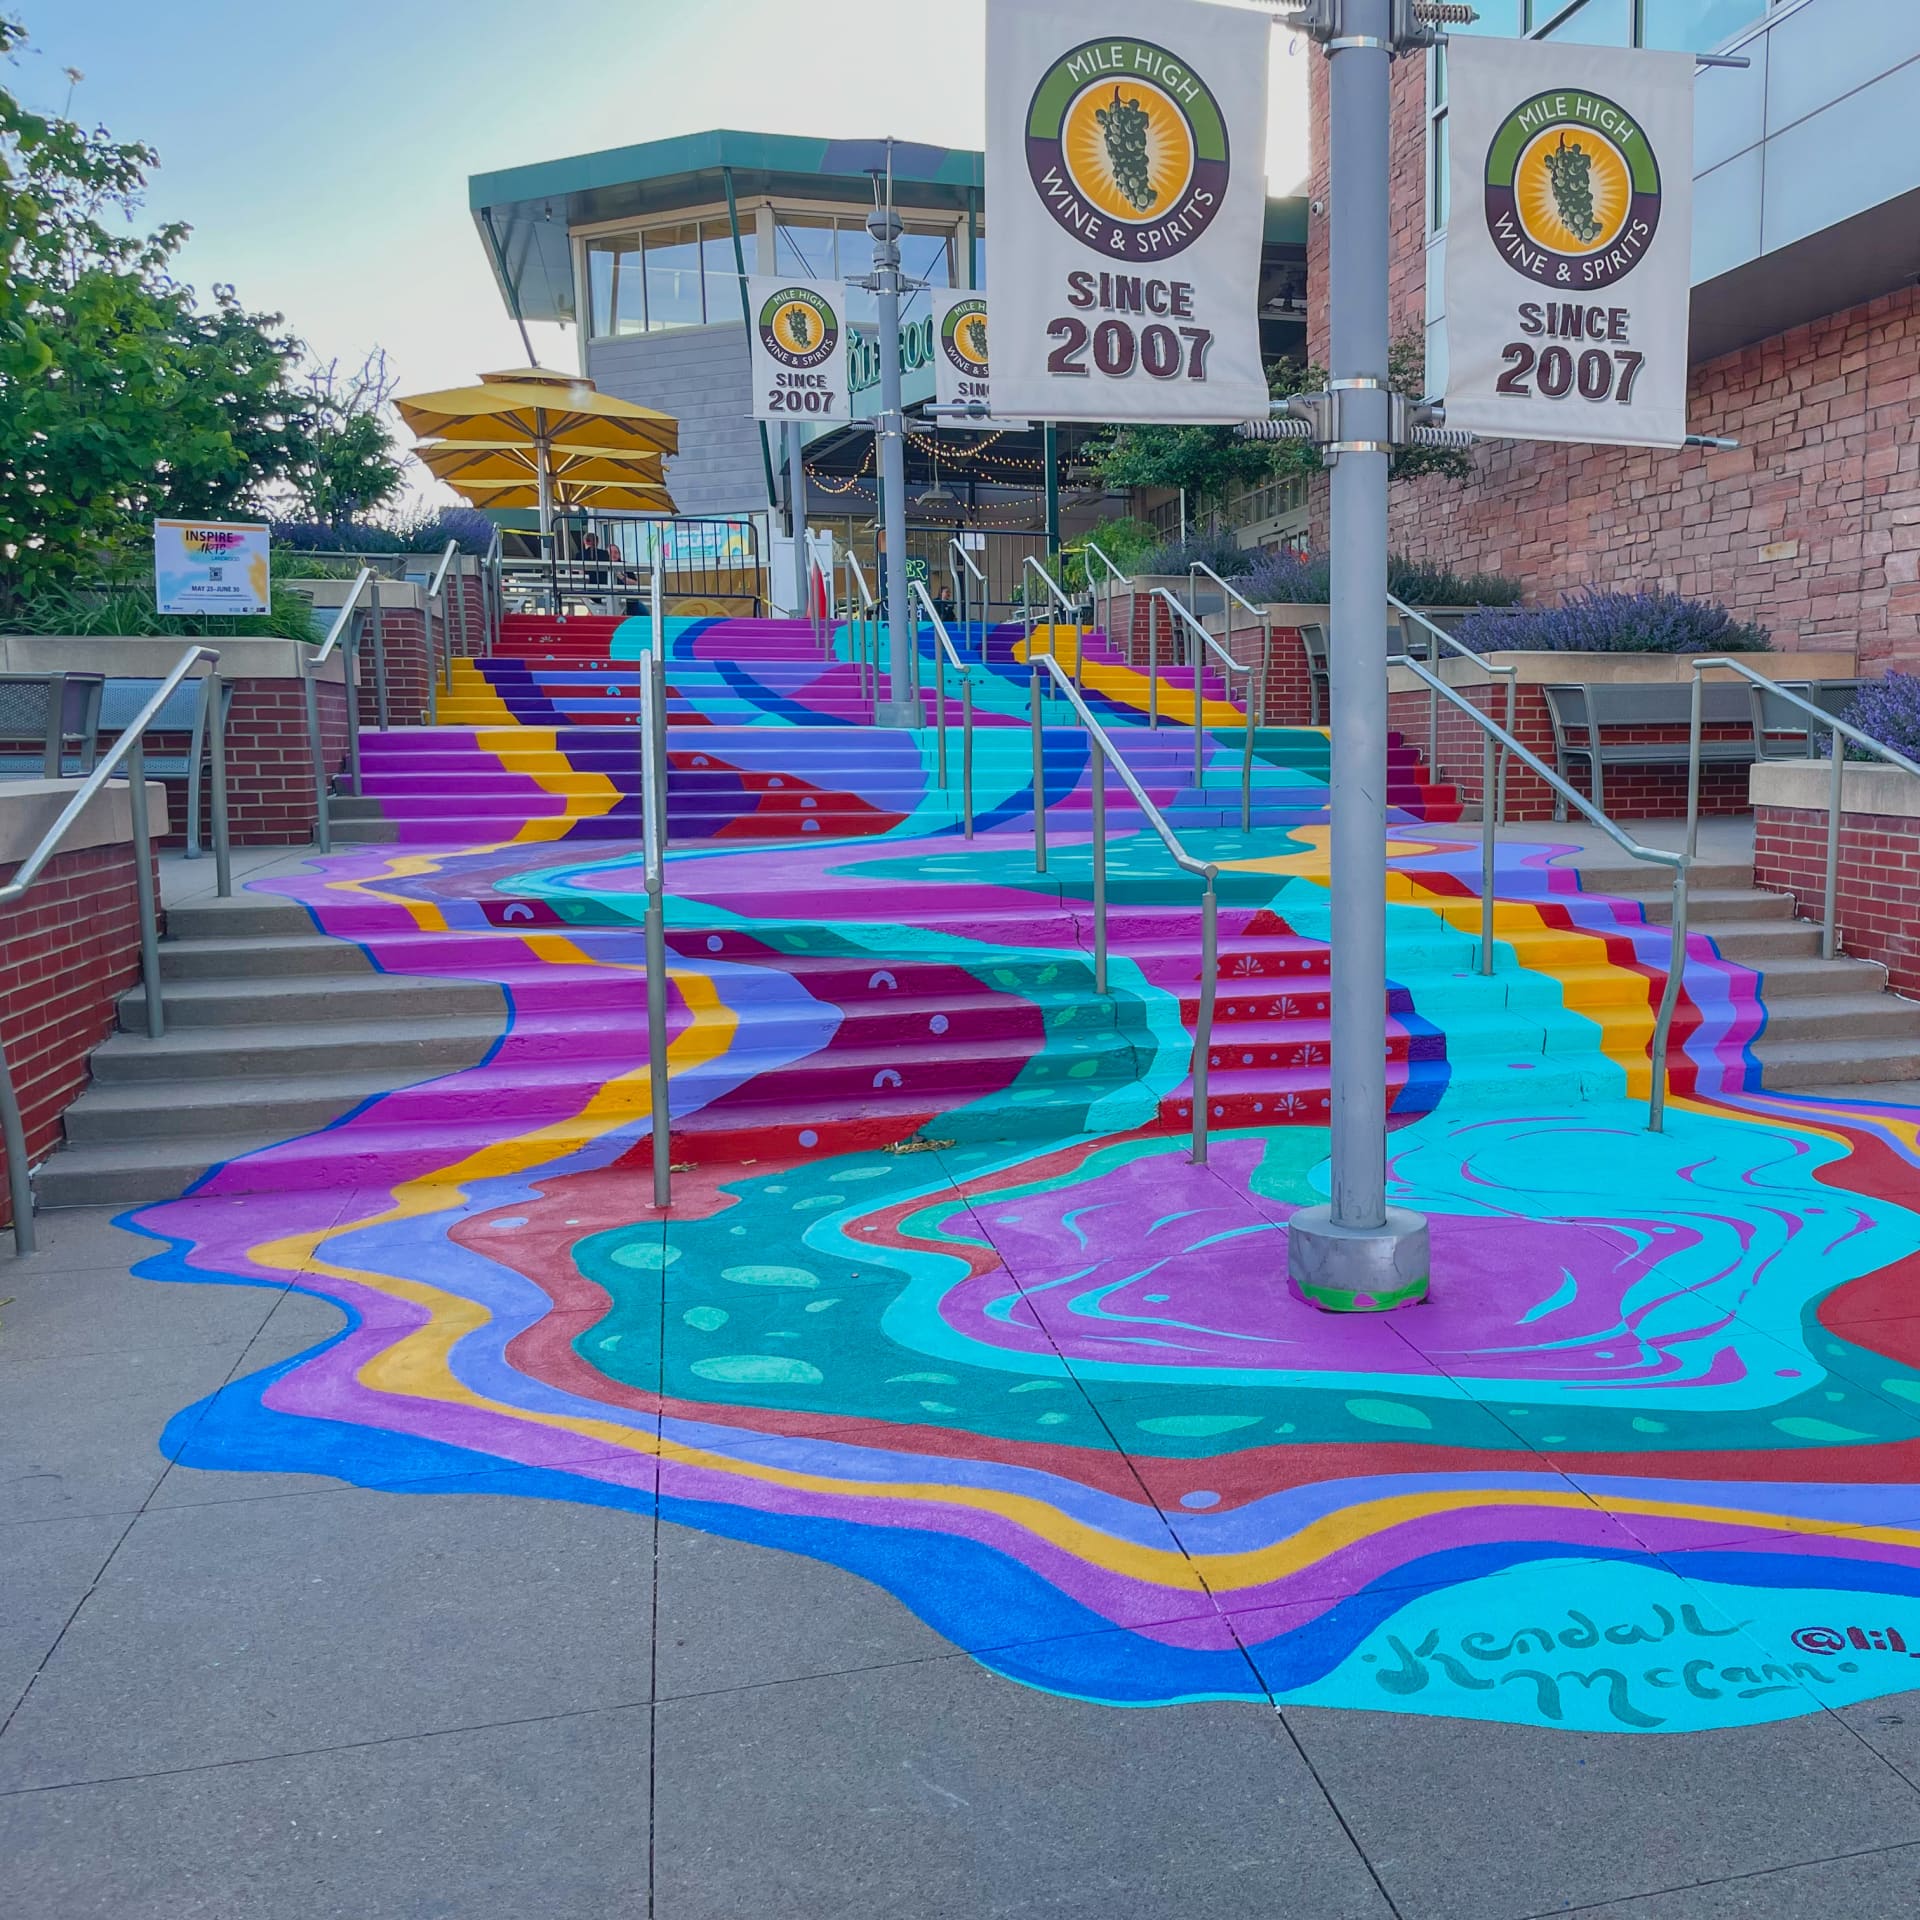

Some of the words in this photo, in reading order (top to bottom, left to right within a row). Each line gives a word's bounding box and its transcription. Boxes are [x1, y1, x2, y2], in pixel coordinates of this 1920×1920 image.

[1066, 46, 1124, 82] MILE
[1134, 48, 1200, 103] HIGH
[1518, 96, 1567, 132] MILE
[1576, 97, 1634, 143] HIGH
[1042, 166, 1102, 240] WINE
[1110, 229, 1126, 251] &
[1136, 187, 1214, 253] SPIRITS
[1495, 211, 1548, 275] WINE
[1556, 263, 1571, 281] &
[1583, 218, 1648, 281] SPIRITS
[774, 290, 796, 305] MILE
[799, 290, 825, 310] HIGH
[954, 303, 975, 316] MILE
[1067, 270, 1193, 318] SINCE
[1518, 302, 1630, 343] SINCE
[766, 335, 789, 362] WINE
[791, 356, 798, 365] &
[803, 339, 834, 366] SPIRITS
[947, 346, 970, 371] WINE
[972, 366, 980, 374] &
[1046, 317, 1213, 380] 2007
[776, 373, 827, 389] SINCE
[958, 382, 989, 397] SIN
[1496, 342, 1644, 403] 2007
[768, 390, 836, 414] 2007
[186, 530, 233, 543] INSPIRE
[1376, 1603, 1757, 1695] Kendall
